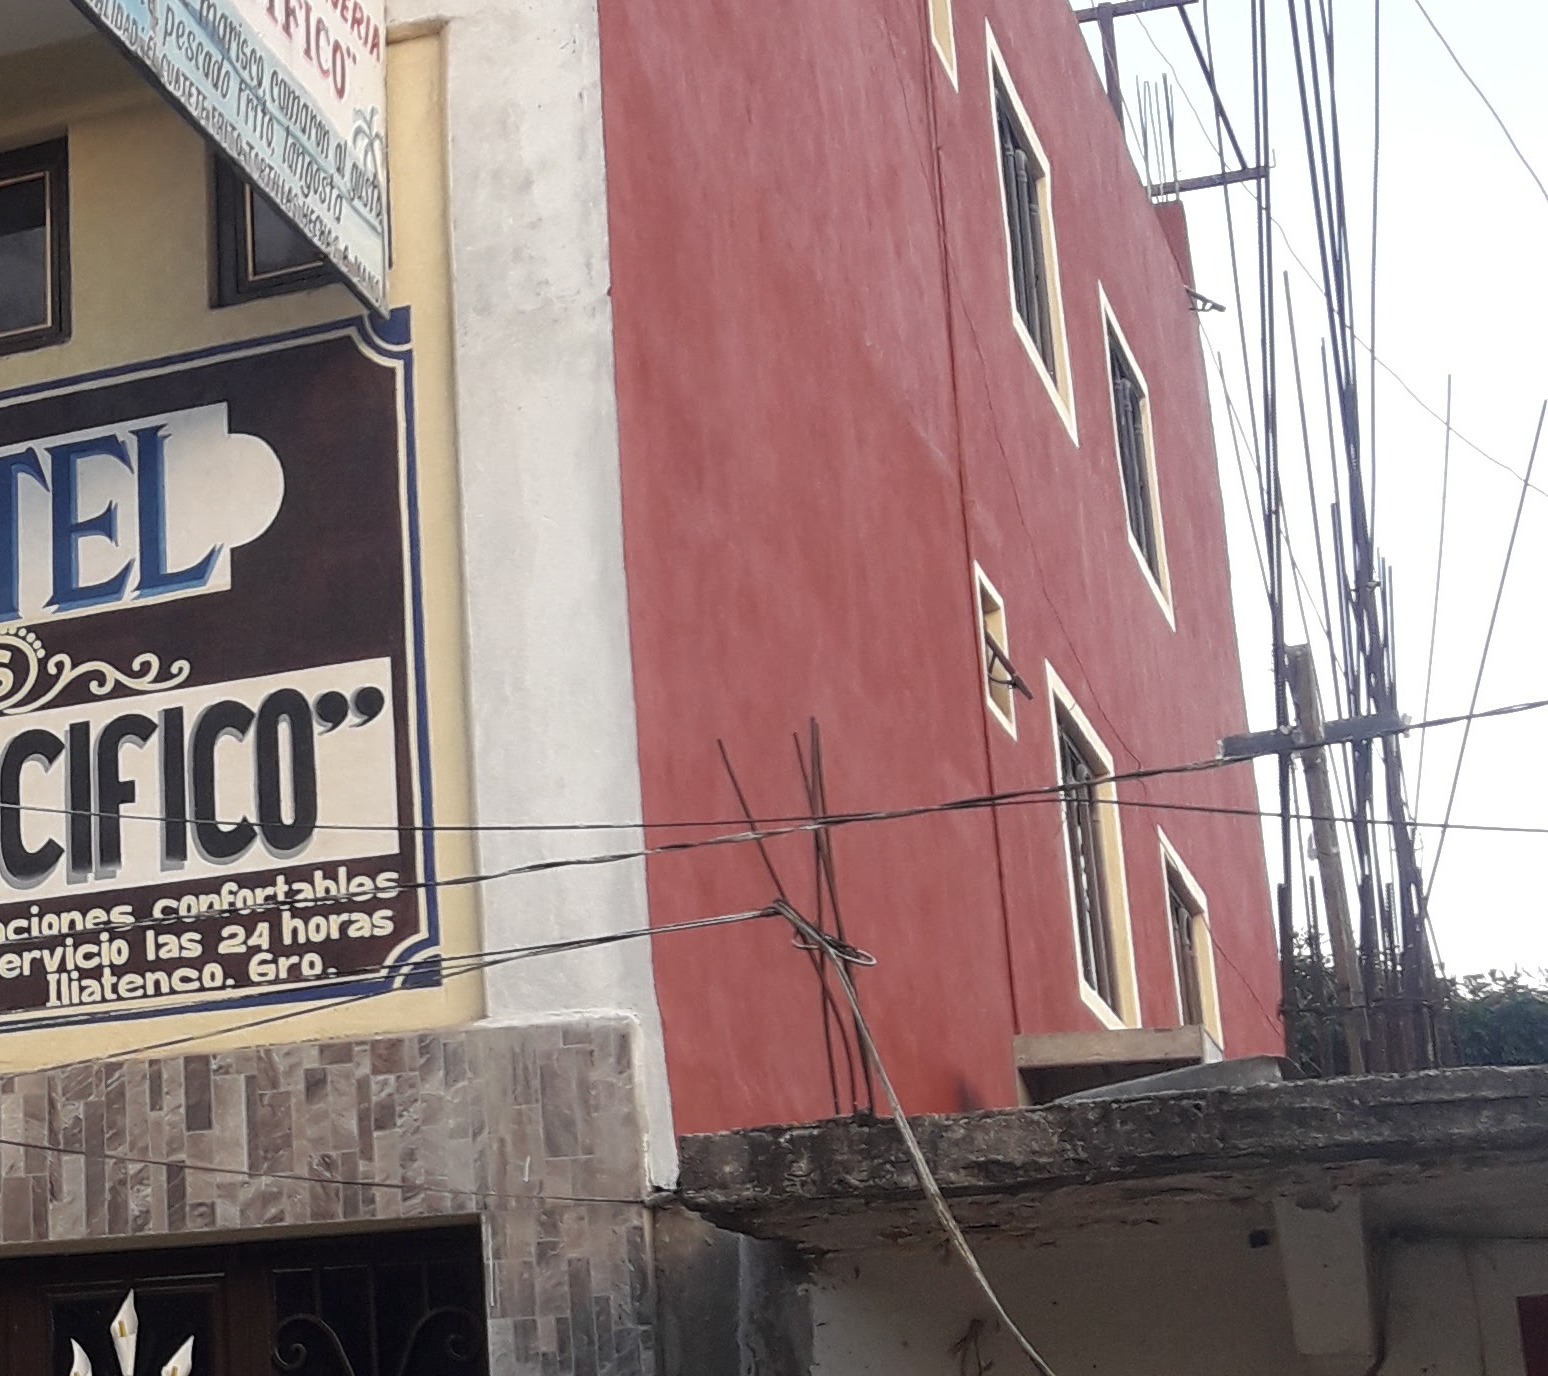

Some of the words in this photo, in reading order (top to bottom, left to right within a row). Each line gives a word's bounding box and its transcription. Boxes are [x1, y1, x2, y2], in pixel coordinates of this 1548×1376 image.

[162, 3, 230, 99] pescado
[282, 125, 343, 224] langosta
[334, 139, 348, 180] al
[152, 865, 400, 921] confortables
[145, 928, 203, 961] las
[217, 921, 270, 954] 24
[281, 905, 395, 946] horas
[248, 951, 338, 982] Gro.
